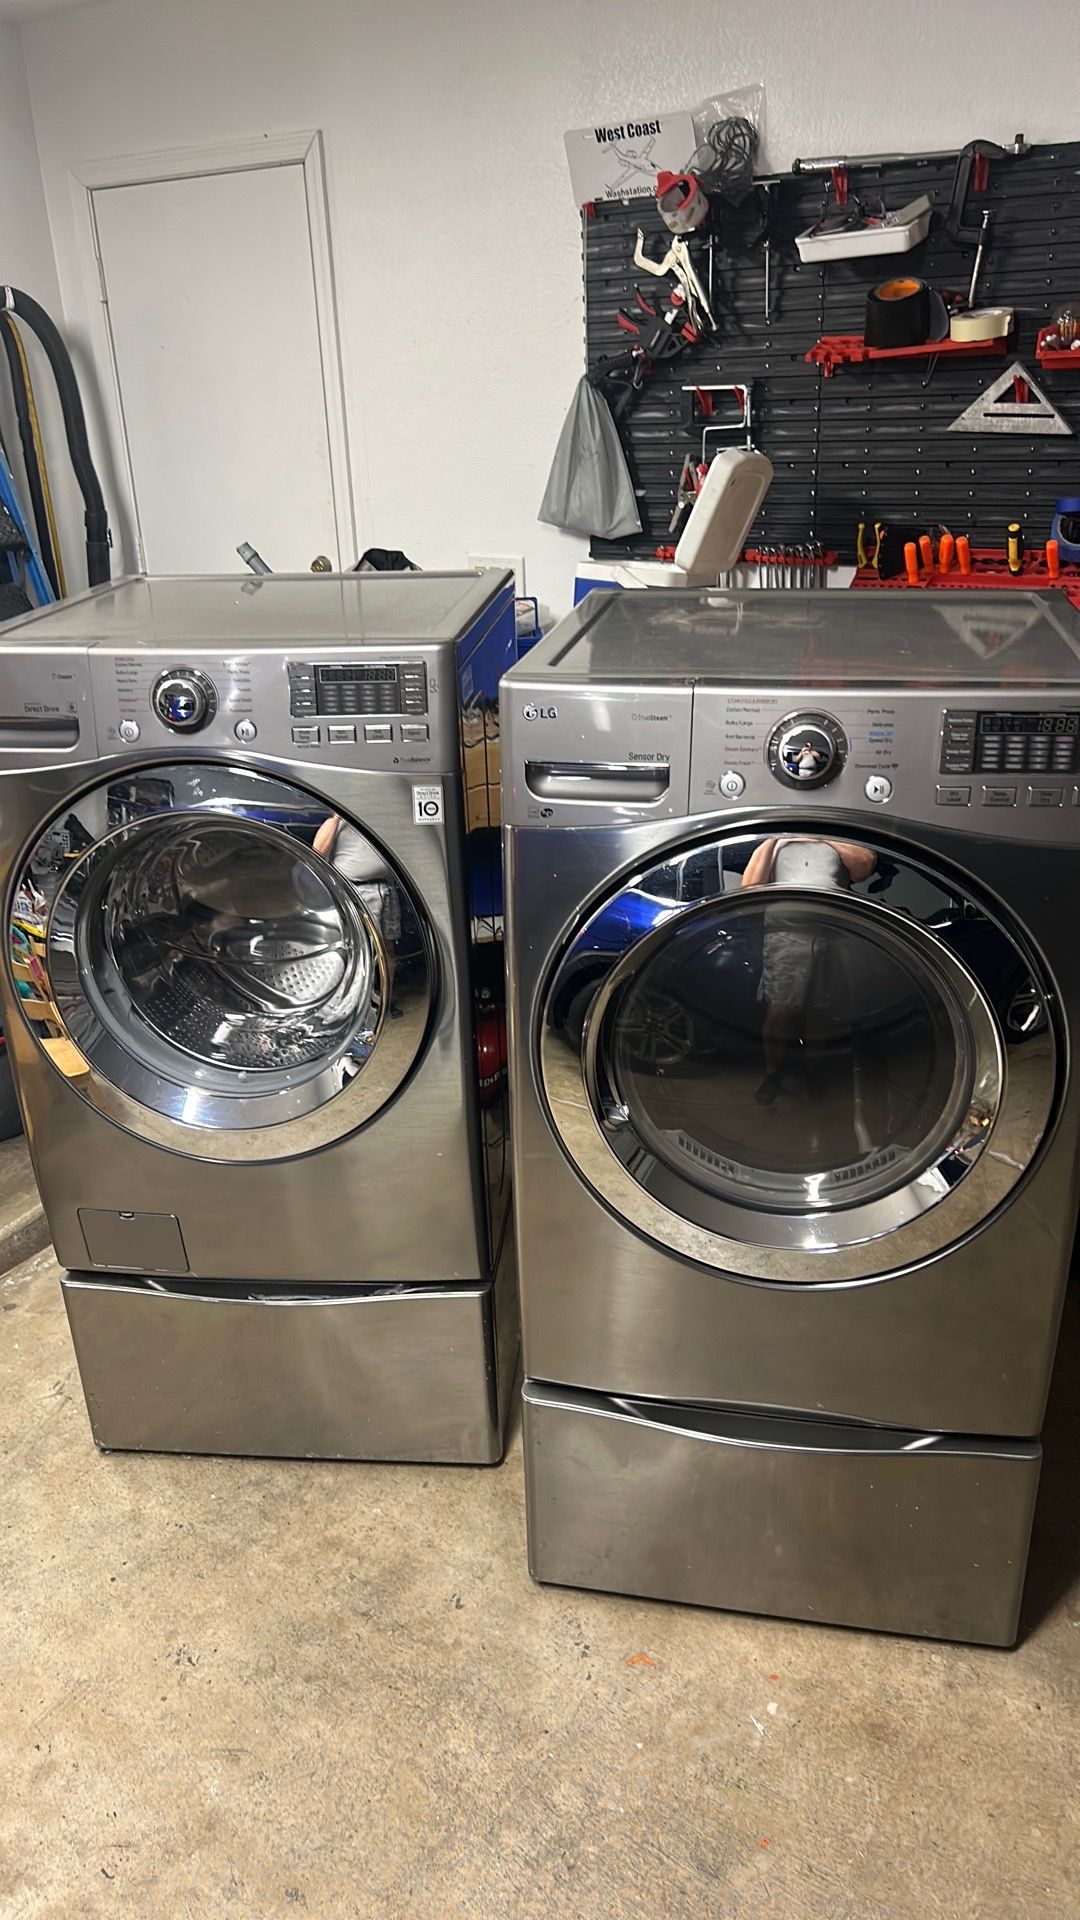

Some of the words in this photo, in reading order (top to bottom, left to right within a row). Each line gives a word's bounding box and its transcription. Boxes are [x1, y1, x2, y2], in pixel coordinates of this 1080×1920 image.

[595, 126, 626, 143] West
[627, 119, 661, 138] Coast
[24, 705, 42, 713] Direct
[43, 705, 60, 713] Drive
[540, 706, 557, 719] LG
[628, 752, 655, 761] Sensor
[656, 752, 670, 762] Dry
[418, 801, 439, 817] 10
